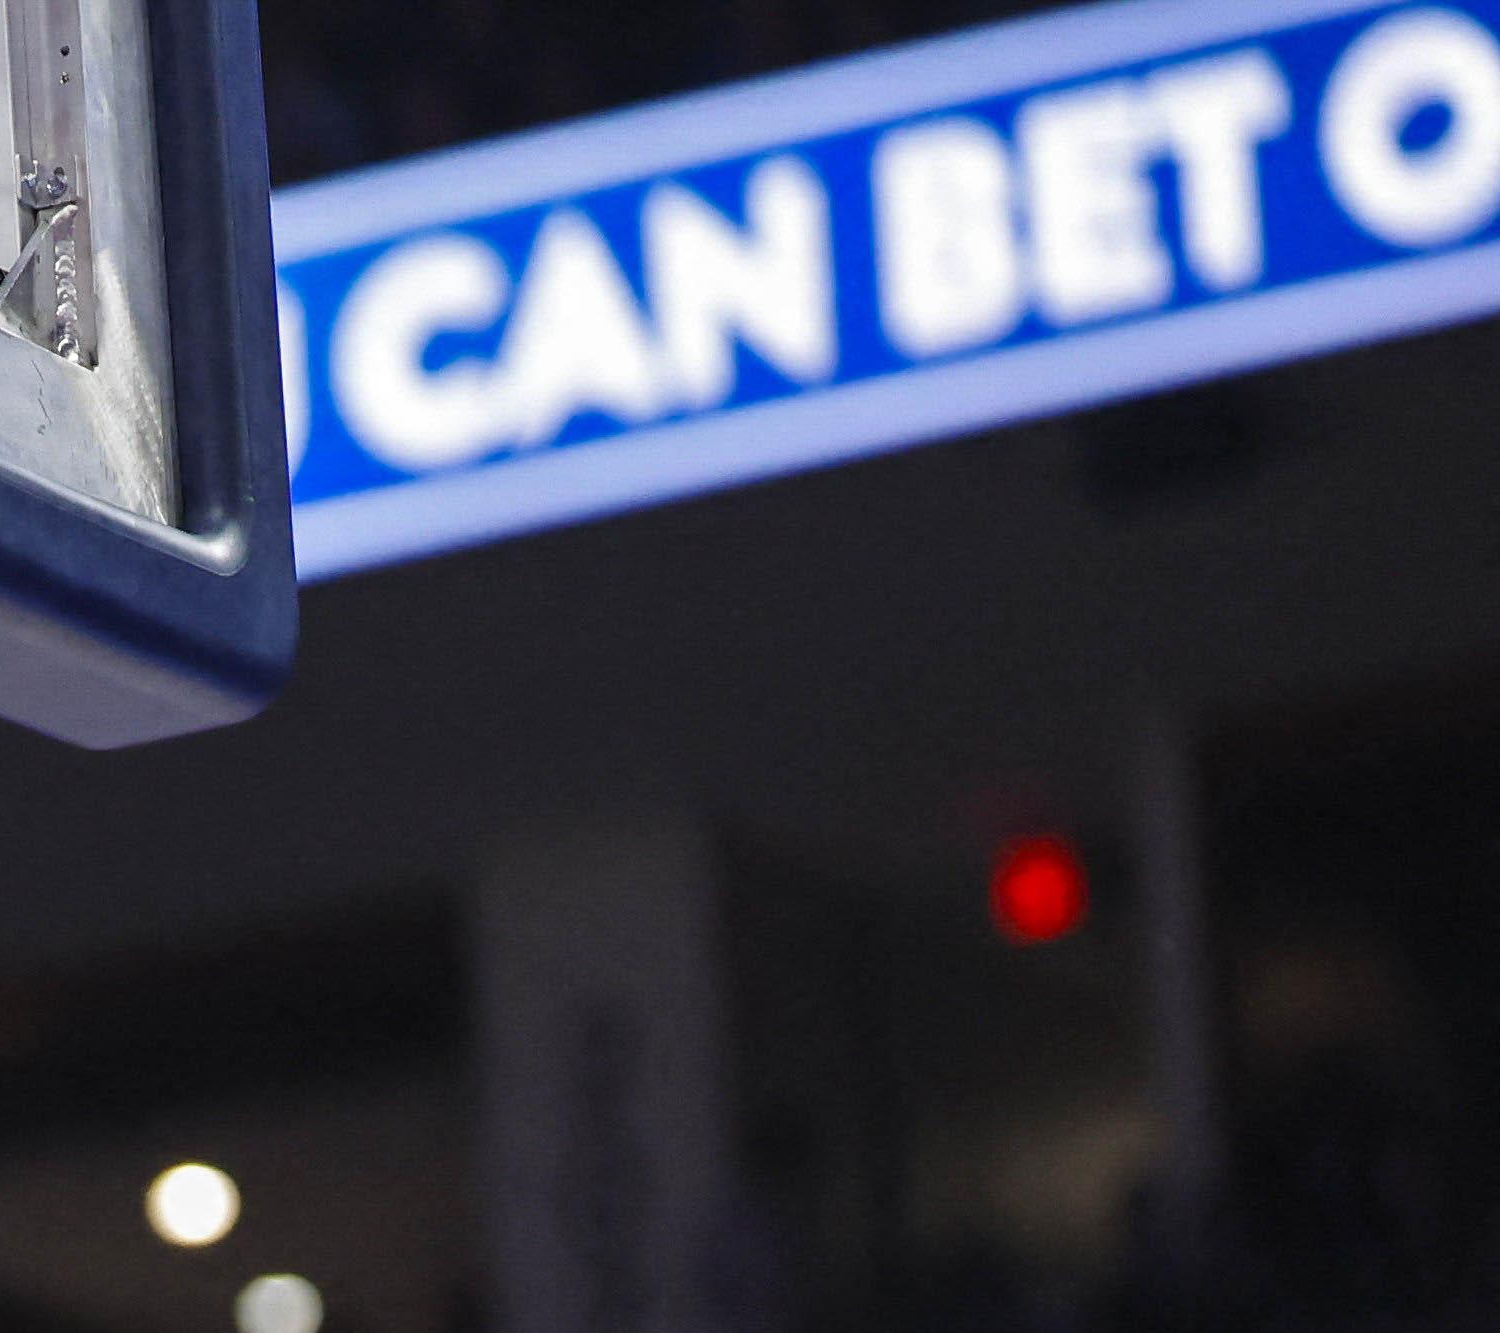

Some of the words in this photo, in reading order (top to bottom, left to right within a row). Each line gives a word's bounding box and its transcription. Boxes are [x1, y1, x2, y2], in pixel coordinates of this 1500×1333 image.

[329, 150, 839, 473] CAN
[869, 45, 1293, 360] BET
[1318, 3, 1500, 249] O
